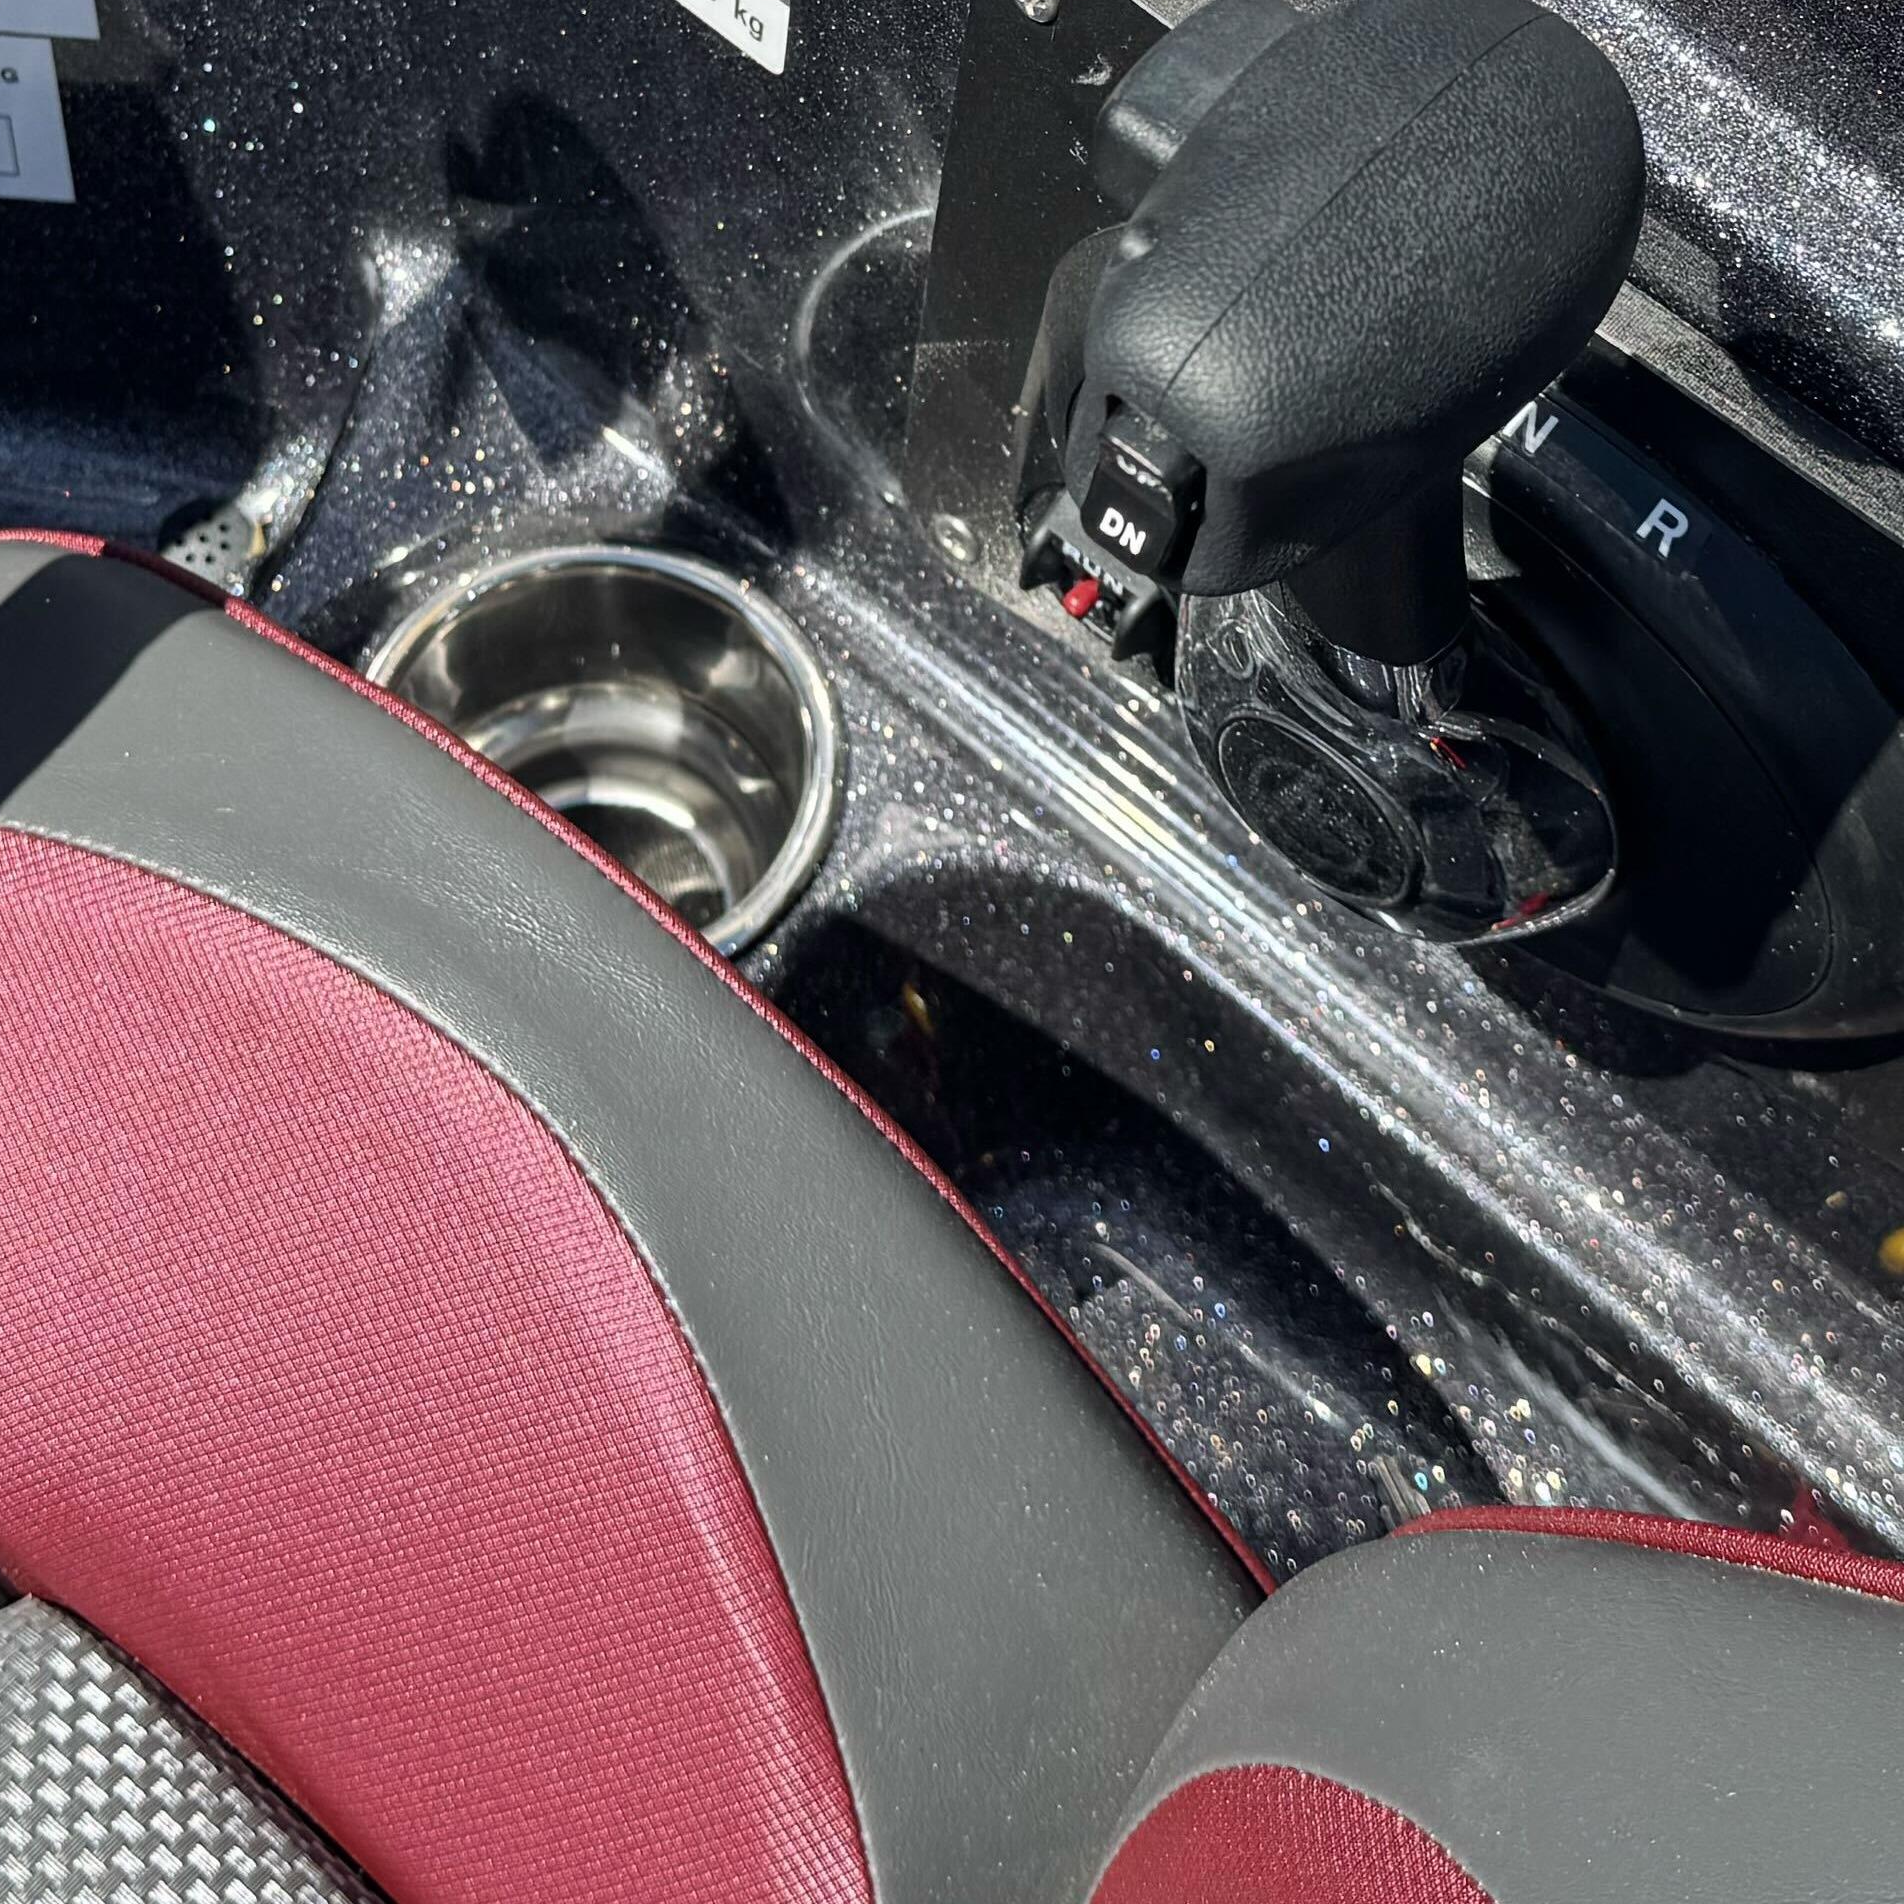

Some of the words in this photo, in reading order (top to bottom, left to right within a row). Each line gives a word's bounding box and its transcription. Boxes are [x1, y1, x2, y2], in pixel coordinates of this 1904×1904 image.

[1502, 400, 1559, 454] N
[1099, 507, 1147, 556] DN
[1636, 498, 1689, 558] R
